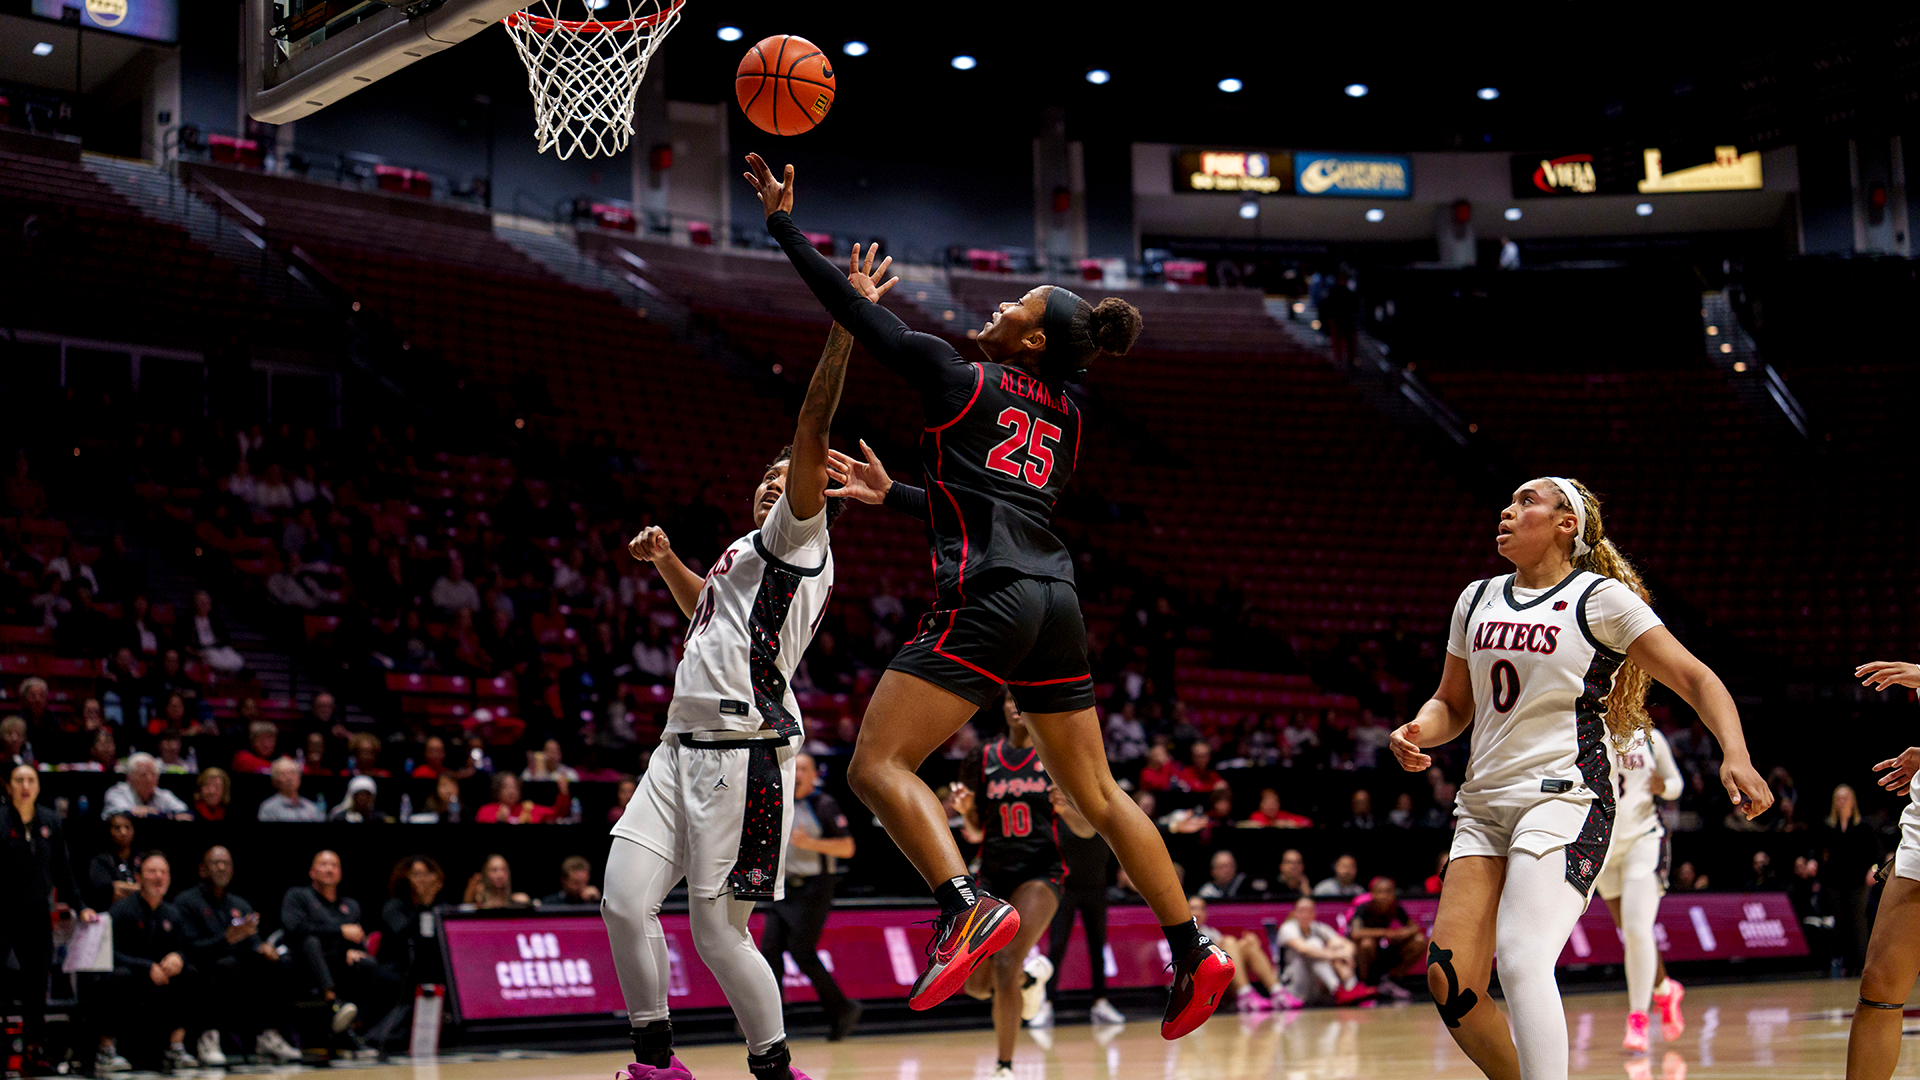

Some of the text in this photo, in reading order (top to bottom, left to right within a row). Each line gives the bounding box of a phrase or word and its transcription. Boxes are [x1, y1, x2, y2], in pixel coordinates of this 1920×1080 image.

[985, 406, 1062, 490] 25
[1472, 620, 1562, 656] AZTECS
[1490, 658, 1521, 714] 0
[999, 801, 1033, 838] 10
[516, 932, 561, 960] LOS
